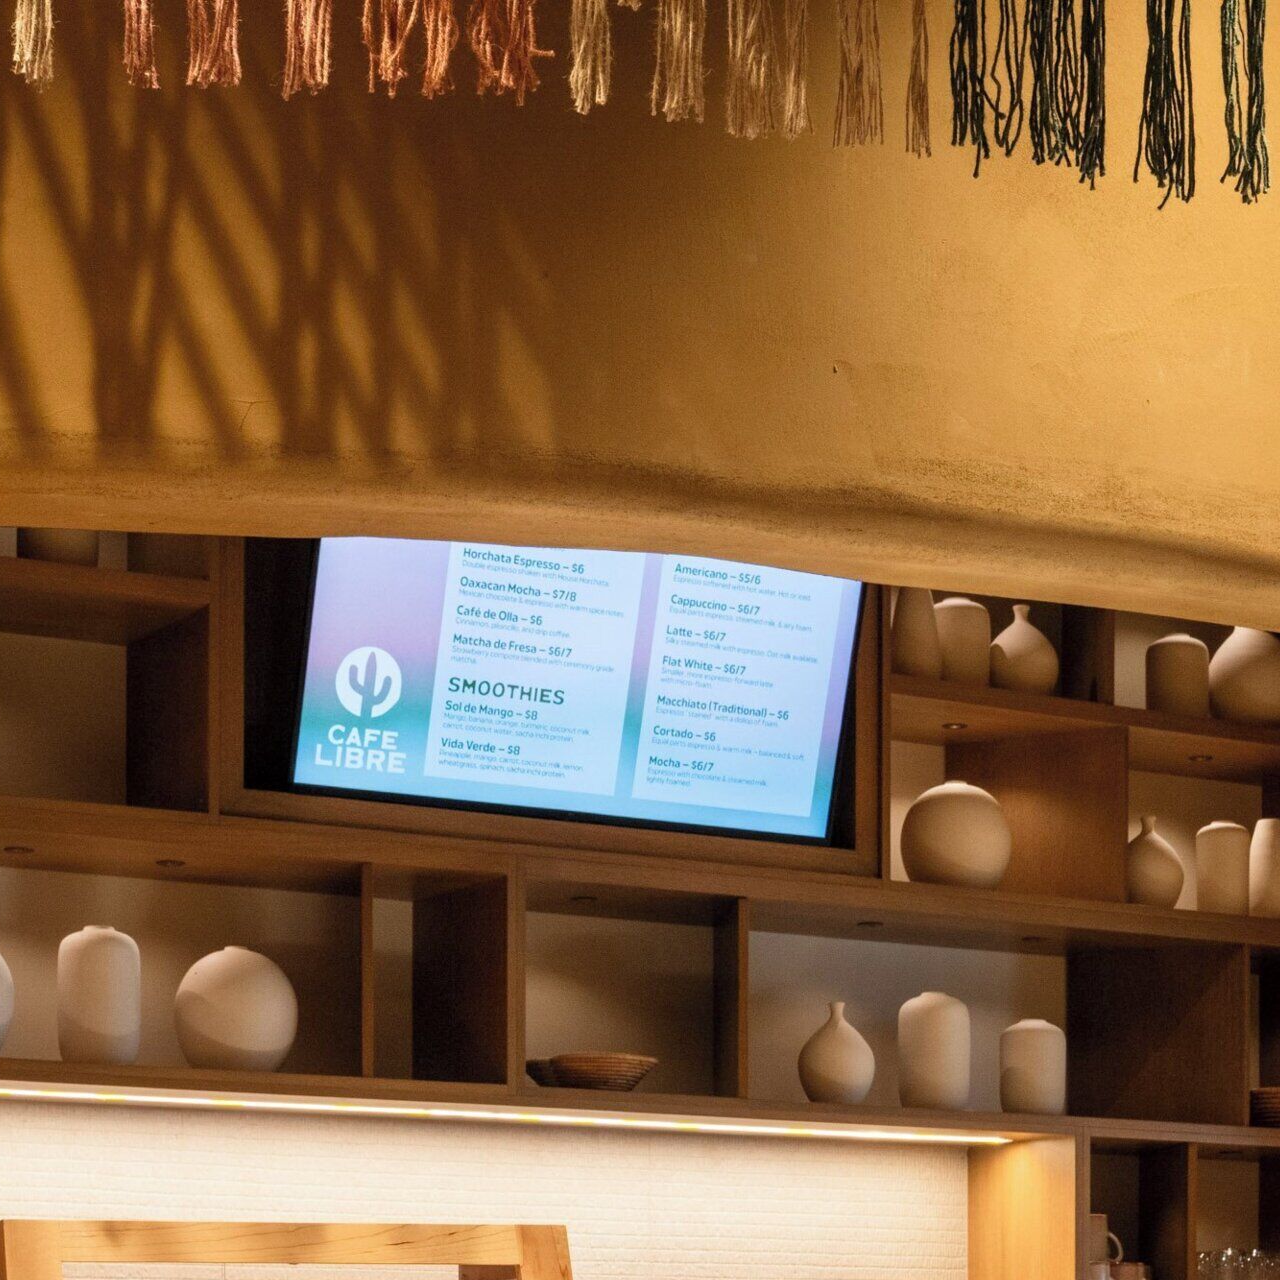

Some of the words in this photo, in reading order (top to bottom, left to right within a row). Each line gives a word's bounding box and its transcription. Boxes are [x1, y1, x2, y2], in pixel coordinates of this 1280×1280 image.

[464, 547, 511, 563] Horchata
[514, 555, 560, 572] Espresso
[572, 563, 584, 573] $6
[675, 563, 729, 579] Americano
[738, 572, 761, 584] $5/6
[460, 577, 506, 592] Oaxacan
[508, 583, 541, 596] Mocha
[552, 589, 576, 601] $7/8
[457, 605, 481, 617] Café
[483, 609, 496, 619] de
[498, 611, 518, 622] Olla
[530, 615, 543, 625] $6
[670, 594, 727, 613] Cappuccino
[738, 604, 760, 615] $6/7
[667, 625, 693, 637] Latte
[703, 630, 726, 641] $6/7
[453, 634, 492, 647] Matcha
[494, 639, 507, 649] de
[509, 641, 537, 653] Fresa
[548, 646, 572, 658] $6/7
[662, 656, 681, 666] Flat
[684, 658, 713, 671] White
[723, 664, 746, 675] $6/7
[448, 676, 565, 705] SMOOTHIES
[445, 700, 462, 711] Sol
[464, 702, 477, 713] de
[479, 704, 514, 719] Mango
[525, 710, 538, 720] $8
[657, 695, 707, 710] Macchiato
[708, 701, 767, 717] (Traditional)
[777, 710, 789, 720] $6
[327, 724, 399, 750] CAFE
[653, 725, 693, 739] Cortado
[704, 732, 716, 741] $6
[441, 737, 464, 749] Vida
[466, 740, 496, 752] Verde
[507, 745, 520, 755] $8
[314, 743, 407, 774] LIBRE
[649, 756, 681, 768] Mocha
[691, 761, 714, 772] $6/7
